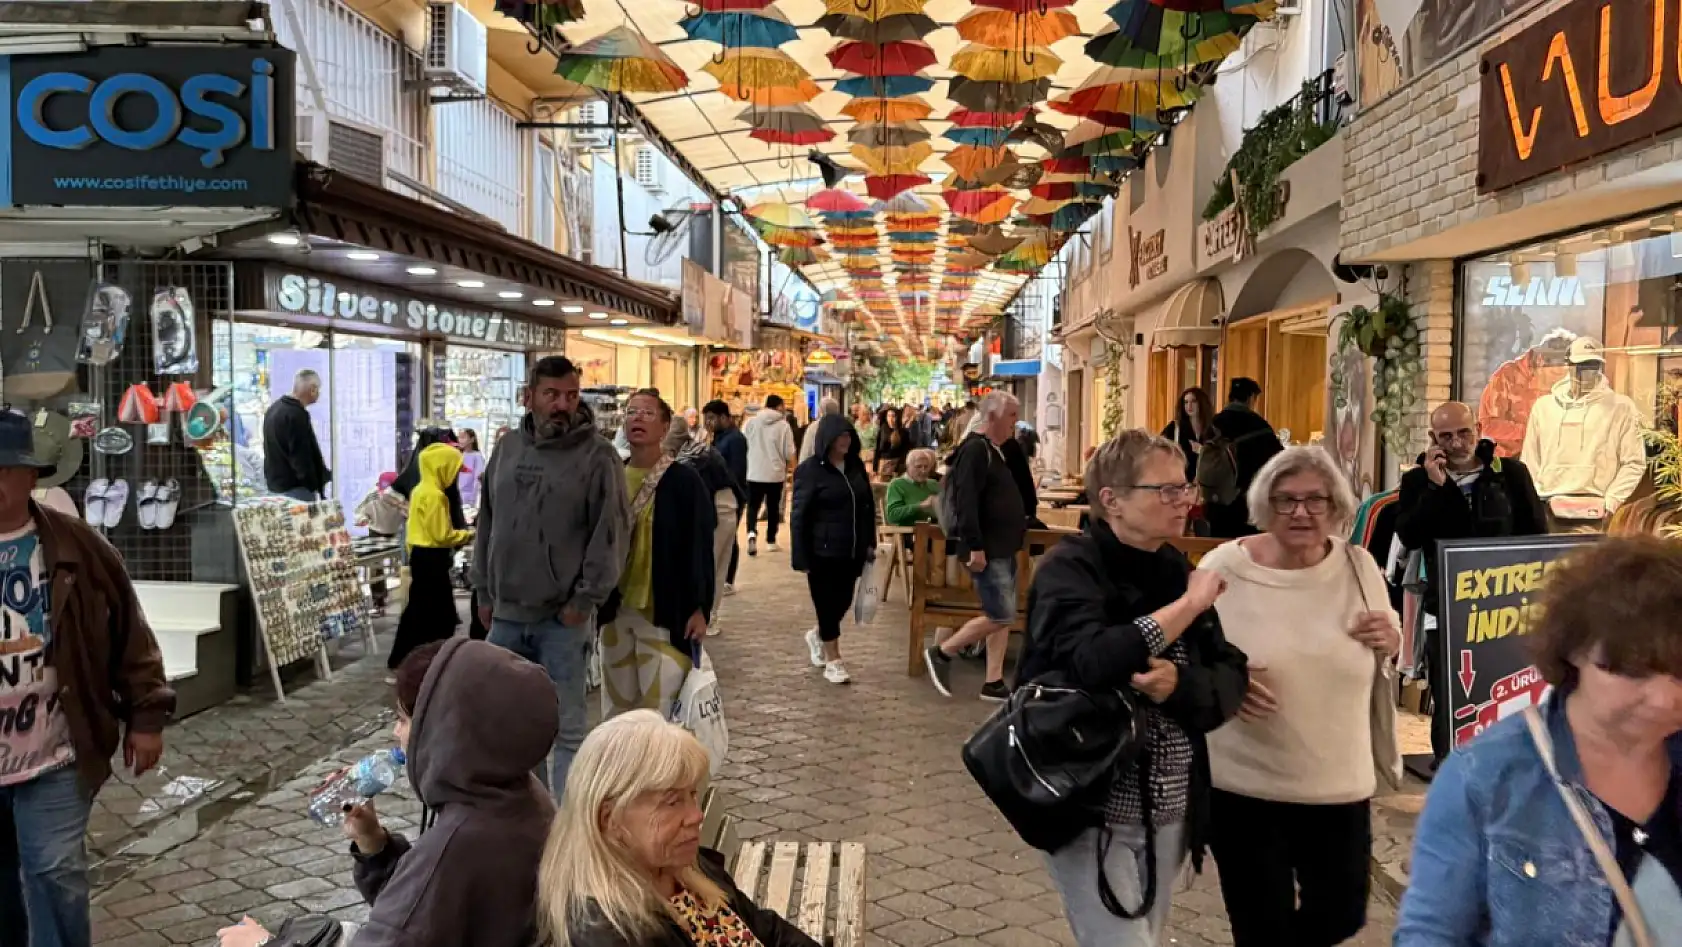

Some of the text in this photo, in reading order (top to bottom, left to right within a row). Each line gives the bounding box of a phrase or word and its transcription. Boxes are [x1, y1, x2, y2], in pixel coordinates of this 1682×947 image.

[54, 175, 248, 192] www.cosifethiye.com
[279, 274, 399, 324] Silver
[1496, 685, 1509, 698] 2.
